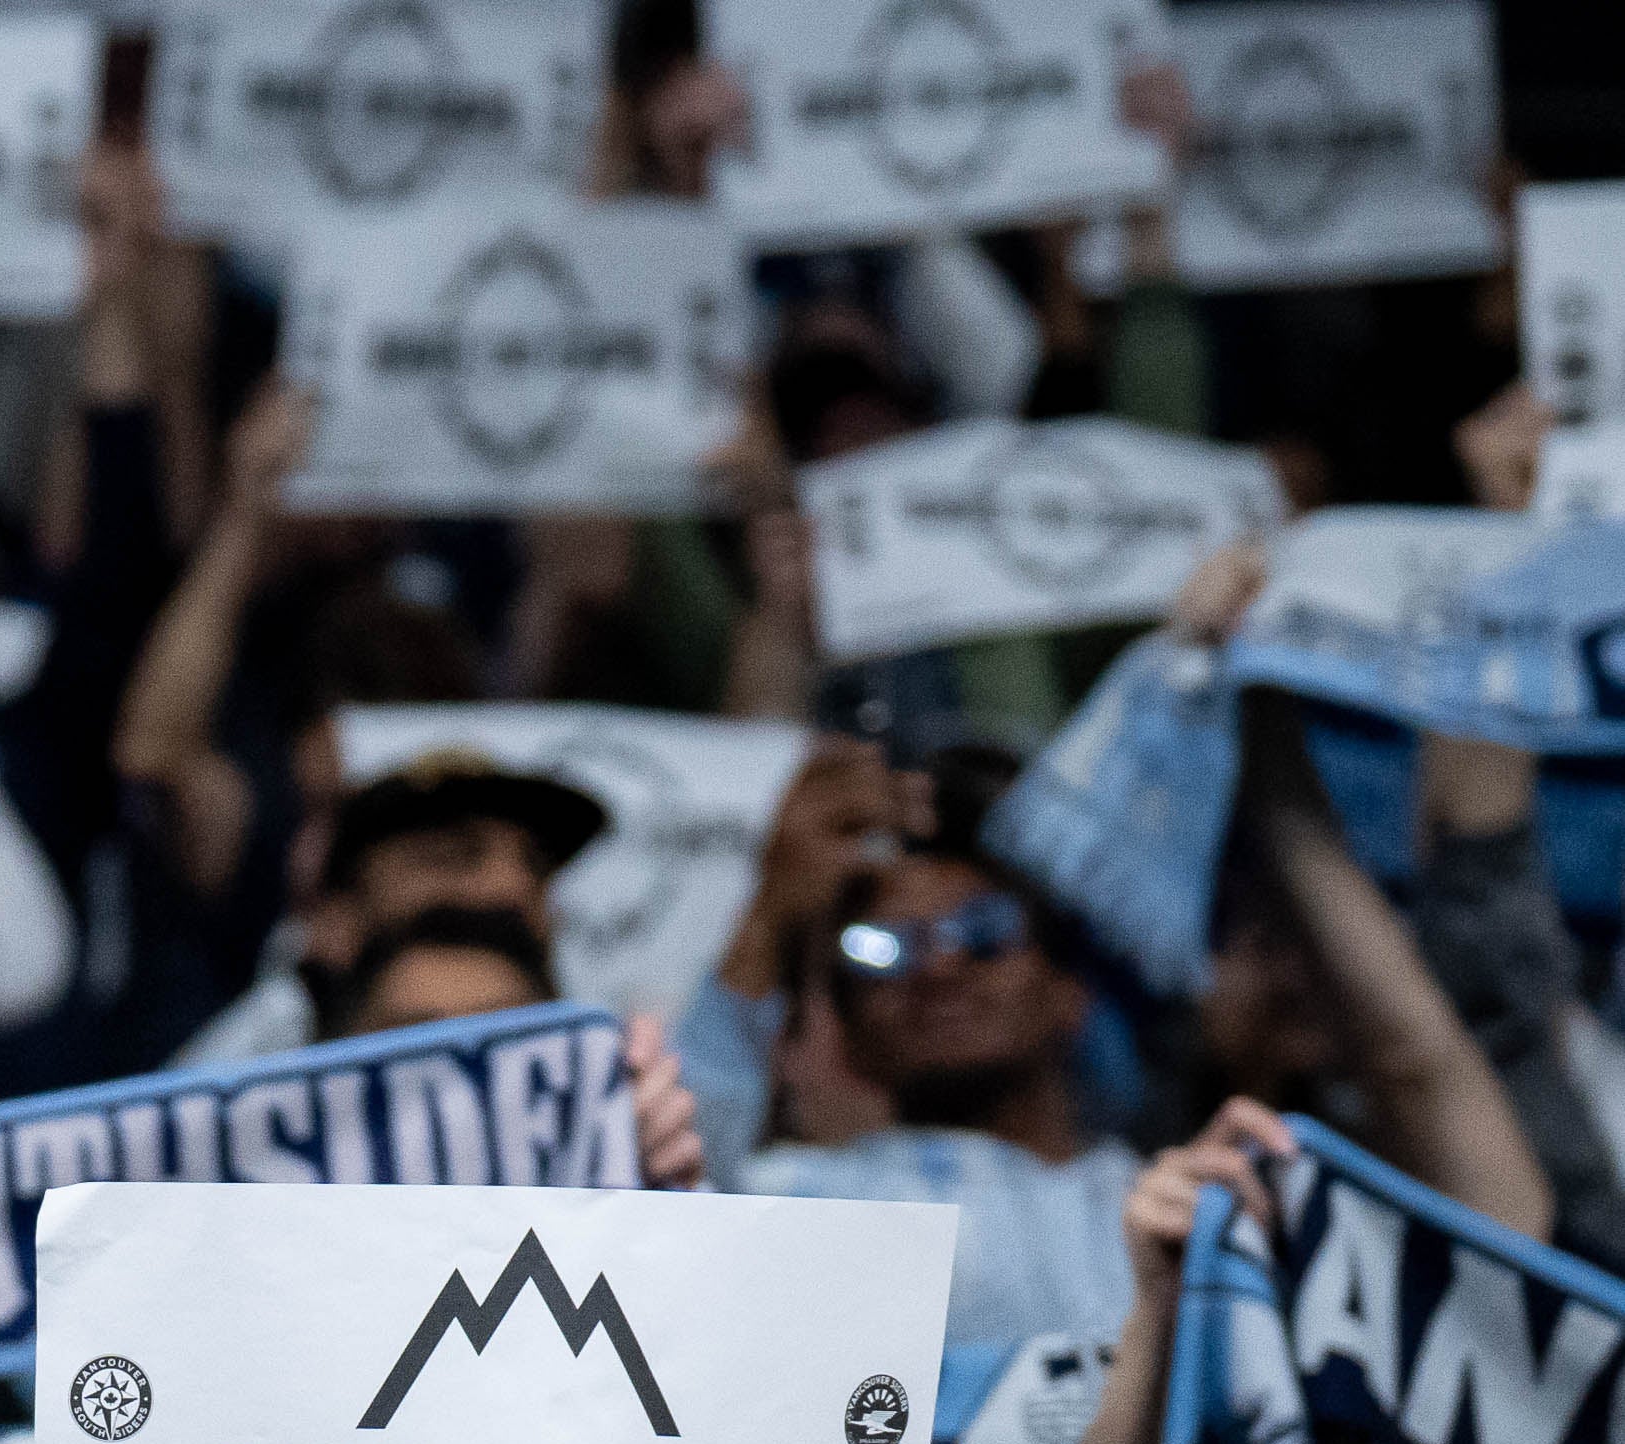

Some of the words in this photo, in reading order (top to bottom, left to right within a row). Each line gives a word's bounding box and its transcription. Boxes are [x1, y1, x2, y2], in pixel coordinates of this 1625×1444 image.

[76, 1358, 146, 1388] VANCOUVER
[74, 1406, 106, 1438] SOUTH
[116, 1406, 148, 1438] SIDERS
